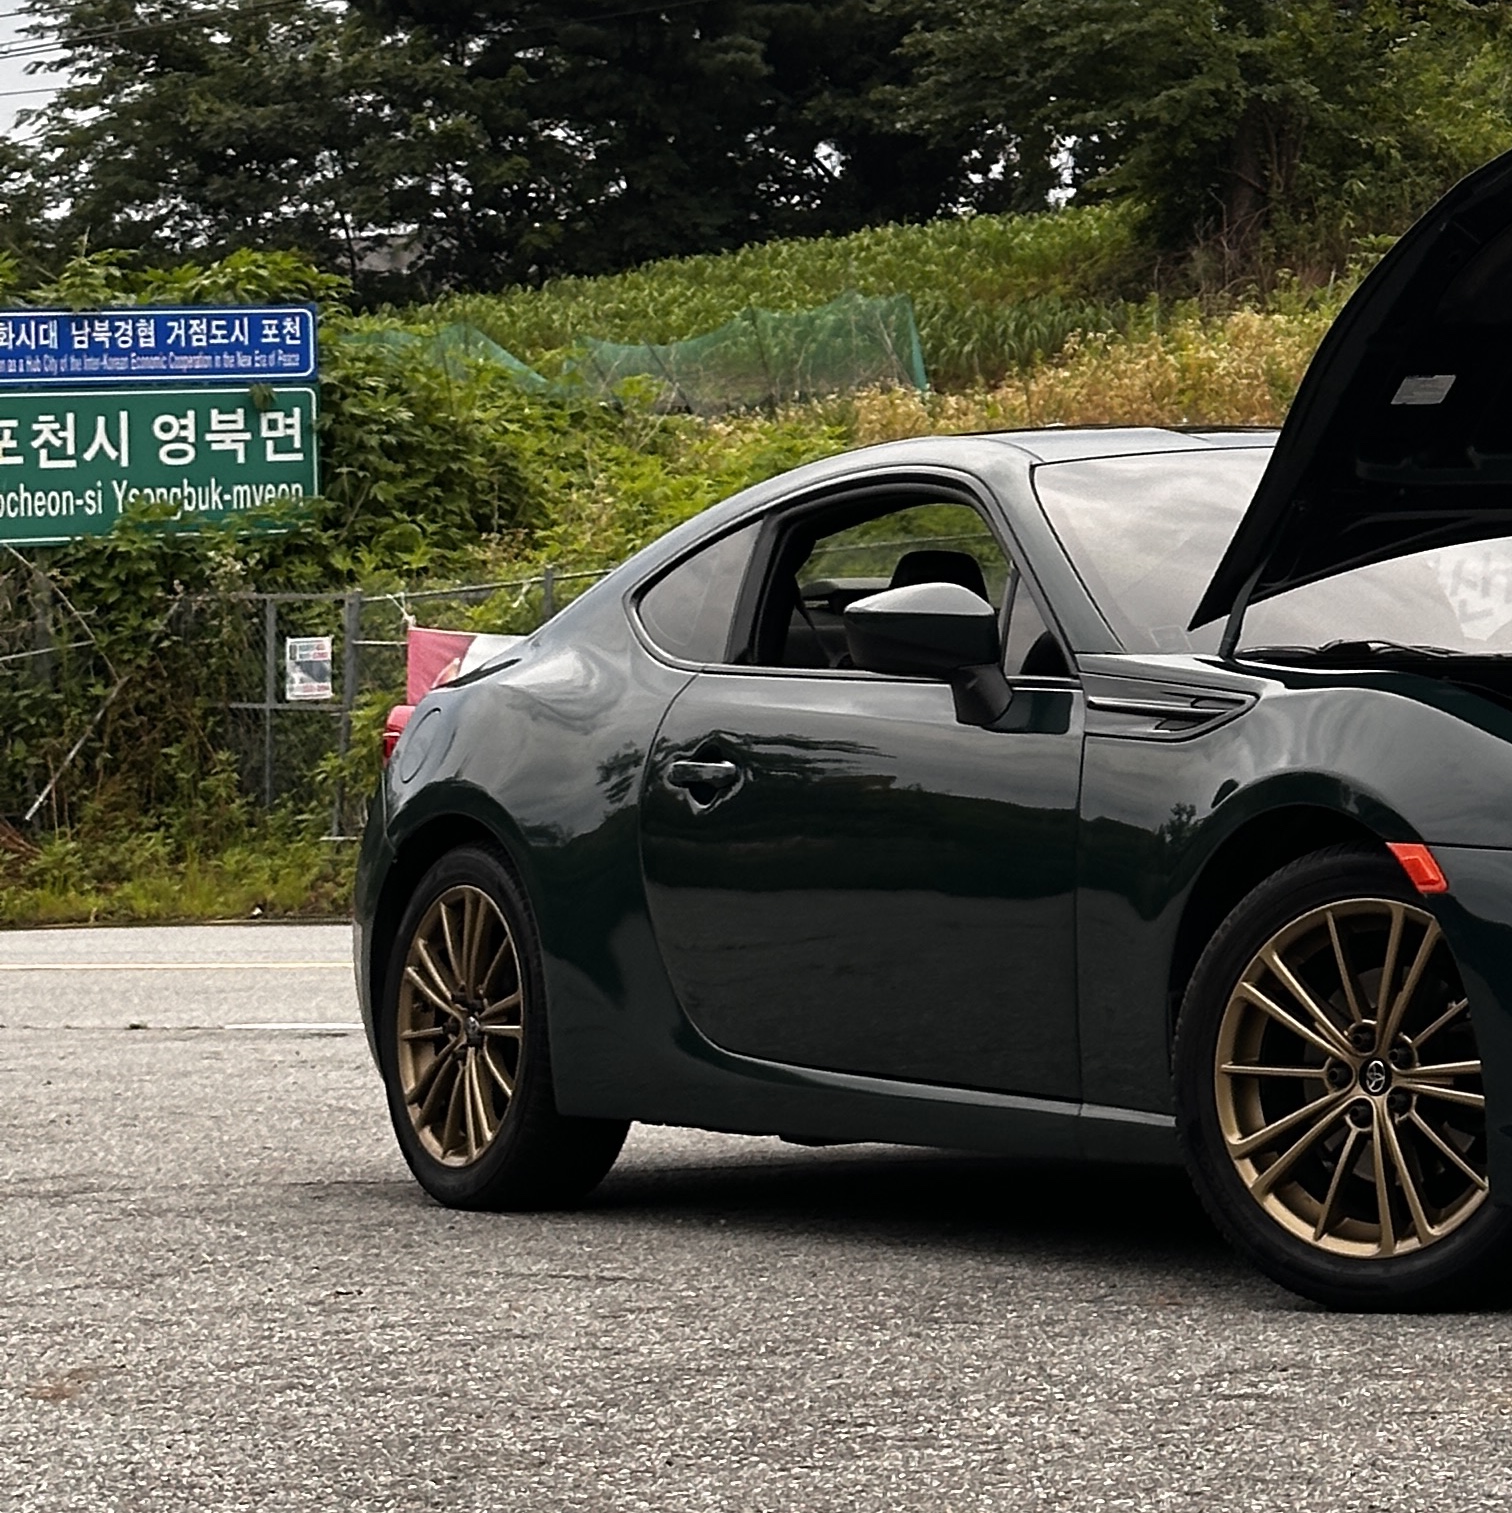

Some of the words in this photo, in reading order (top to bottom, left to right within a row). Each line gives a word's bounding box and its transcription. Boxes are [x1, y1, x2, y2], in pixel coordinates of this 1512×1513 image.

[71, 318, 156, 350] 남북경협
[166, 317, 249, 348] 거점도시
[261, 316, 301, 346] 포천
[152, 406, 304, 467] 영북면
